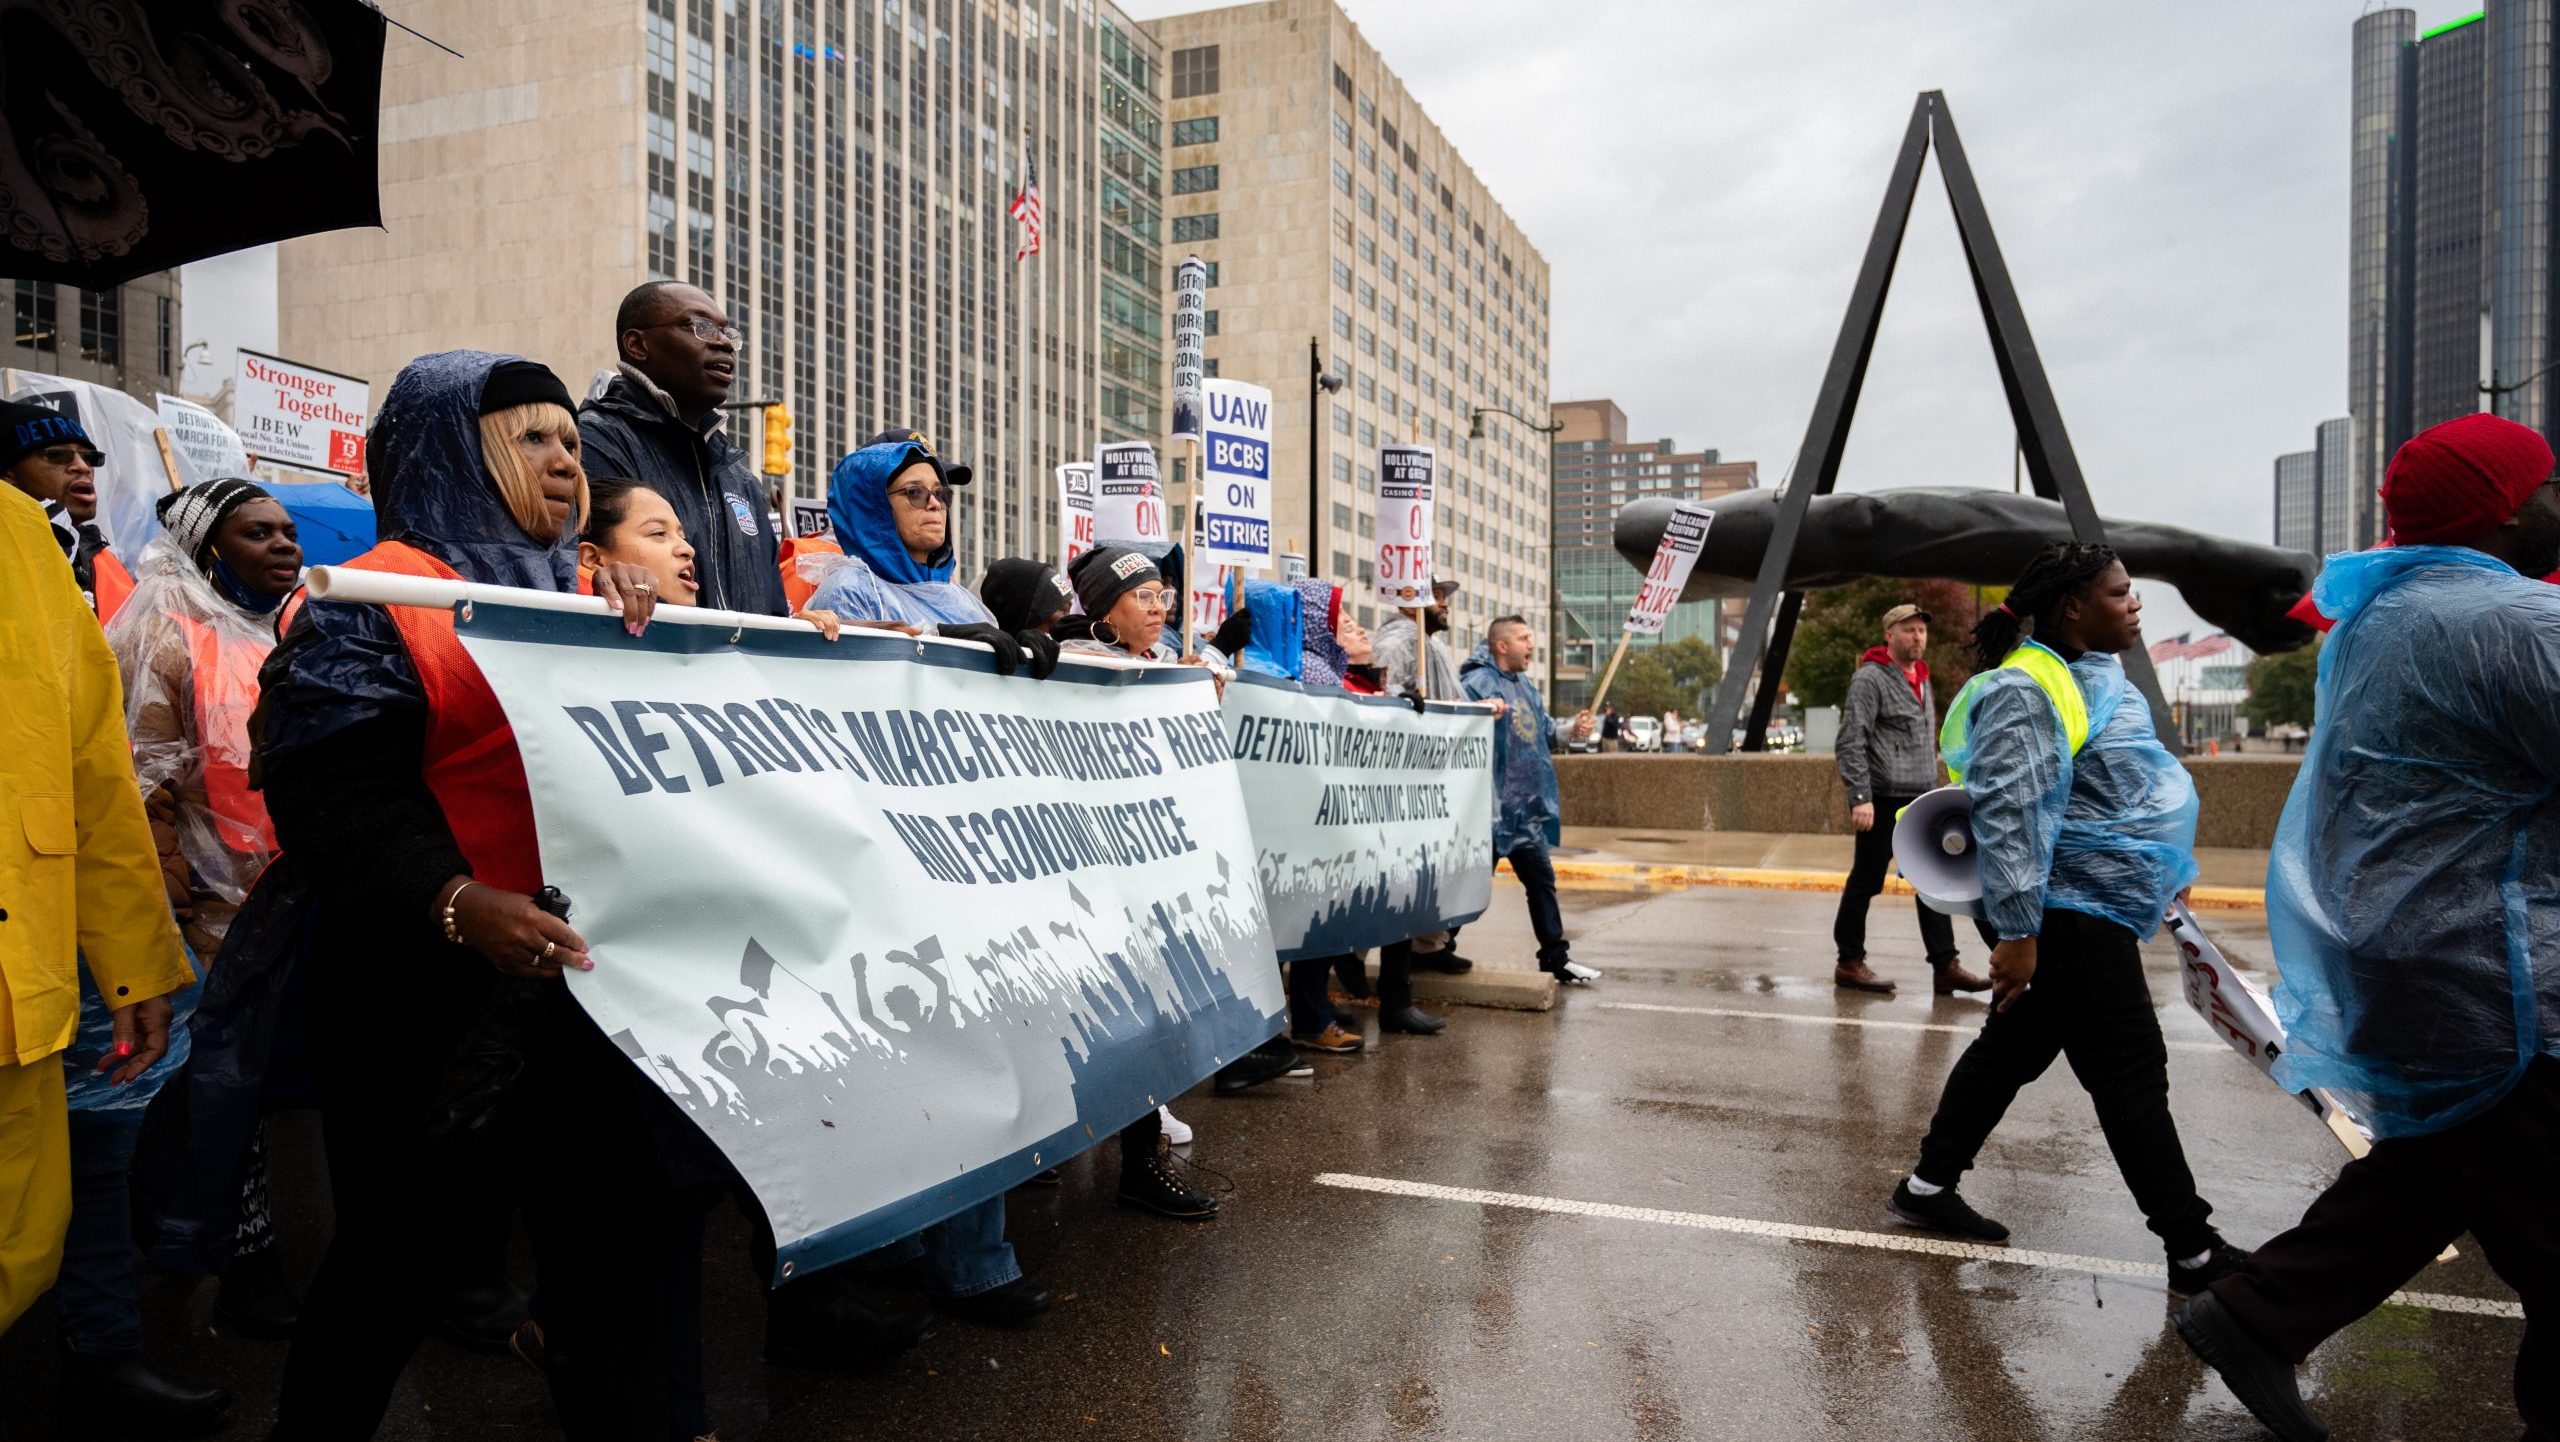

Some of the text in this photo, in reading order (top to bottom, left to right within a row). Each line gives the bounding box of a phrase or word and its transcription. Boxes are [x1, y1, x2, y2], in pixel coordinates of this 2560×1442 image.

[246, 358, 337, 398] Stronger
[274, 388, 364, 427] Together
[1209, 391, 1268, 431] UAW
[15, 416, 86, 446] DETRO
[252, 415, 302, 438] IBEW
[1117, 464, 1129, 476] AT
[1214, 439, 1265, 472] BCBS
[1227, 483, 1255, 510] ON
[1383, 488, 1414, 497] CASINO
[1074, 514, 1093, 543] NE
[1136, 500, 1160, 536] ON
[1209, 518, 1269, 548] STRIKE
[1410, 504, 1422, 540] O
[561, 697, 869, 796] DETROIT'S
[841, 709, 1005, 787] MARCH
[979, 713, 1058, 777] FOR
[1032, 718, 1162, 782] WORKERS'
[1234, 713, 1332, 767] DETROIT'S
[1333, 722, 1383, 769] MARCH
[1379, 730, 1404, 769] FOR
[1402, 733, 1448, 770] WORKER
[1315, 784, 1449, 826] AND ECONOMIC JUSTICE
[881, 808, 977, 885] AND
[1091, 796, 1198, 867] JUSTICE
